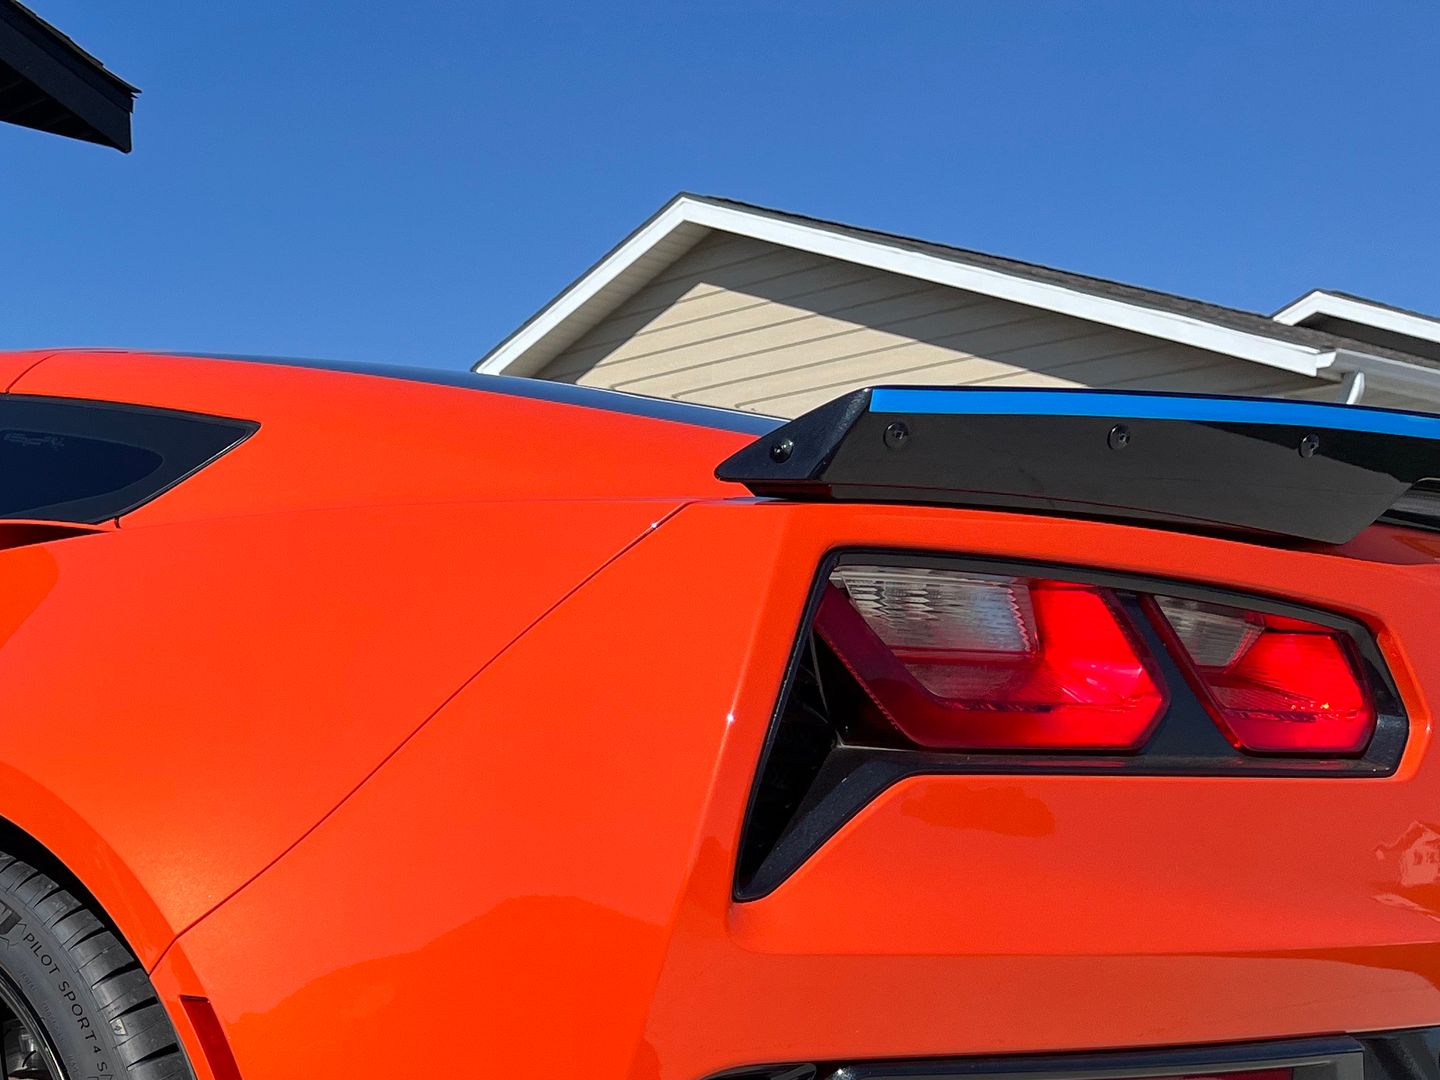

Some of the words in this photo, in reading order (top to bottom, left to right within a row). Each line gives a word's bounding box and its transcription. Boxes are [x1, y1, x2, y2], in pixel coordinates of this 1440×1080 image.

[23, 932, 60, 974] PILOT
[58, 980, 98, 1042] SPORT
[92, 1044, 102, 1054] 4
[96, 1061, 108, 1072] S
